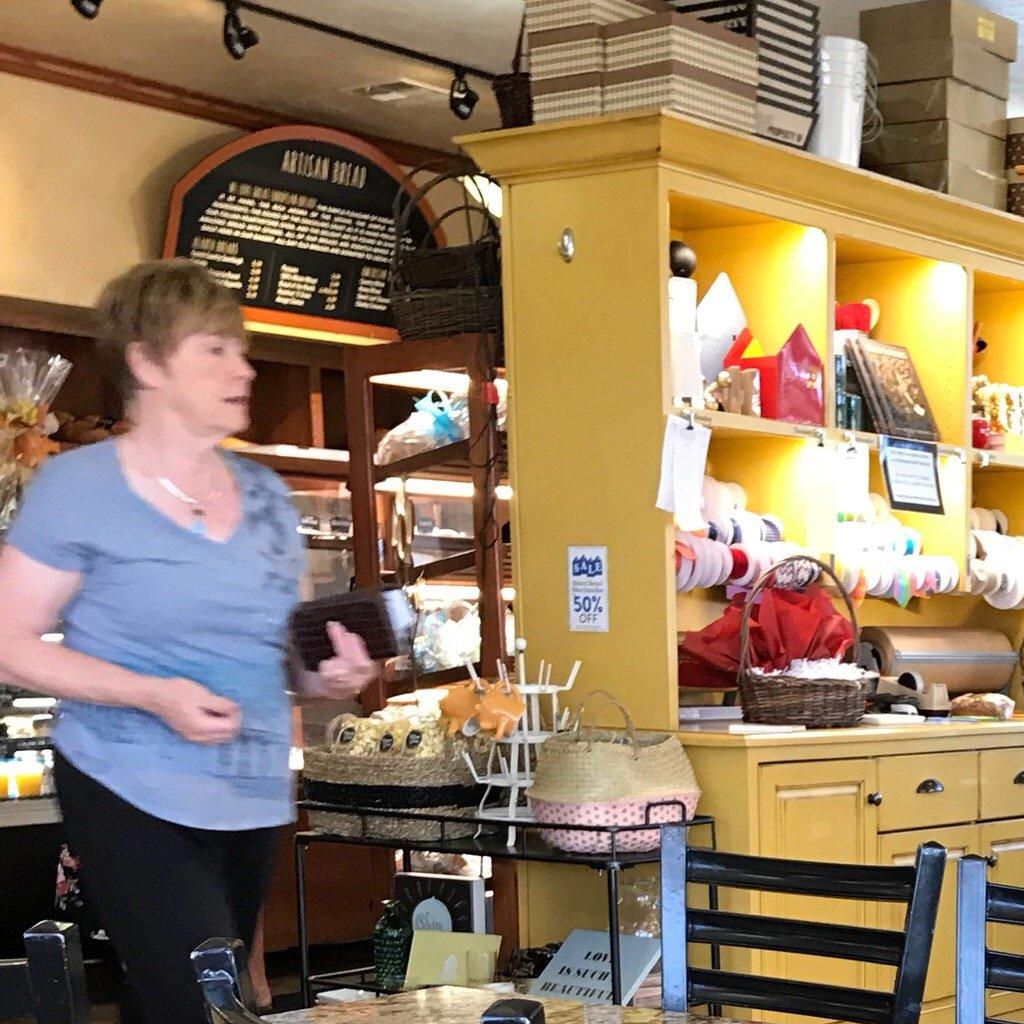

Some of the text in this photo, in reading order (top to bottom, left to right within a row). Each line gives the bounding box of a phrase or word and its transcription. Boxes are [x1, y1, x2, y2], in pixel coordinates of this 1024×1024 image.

[574, 561, 602, 573] SALE
[574, 596, 603, 613] 50%
[580, 614, 599, 623] OFF
[583, 951, 612, 963] LOV
[576, 968, 610, 981] SUCH
